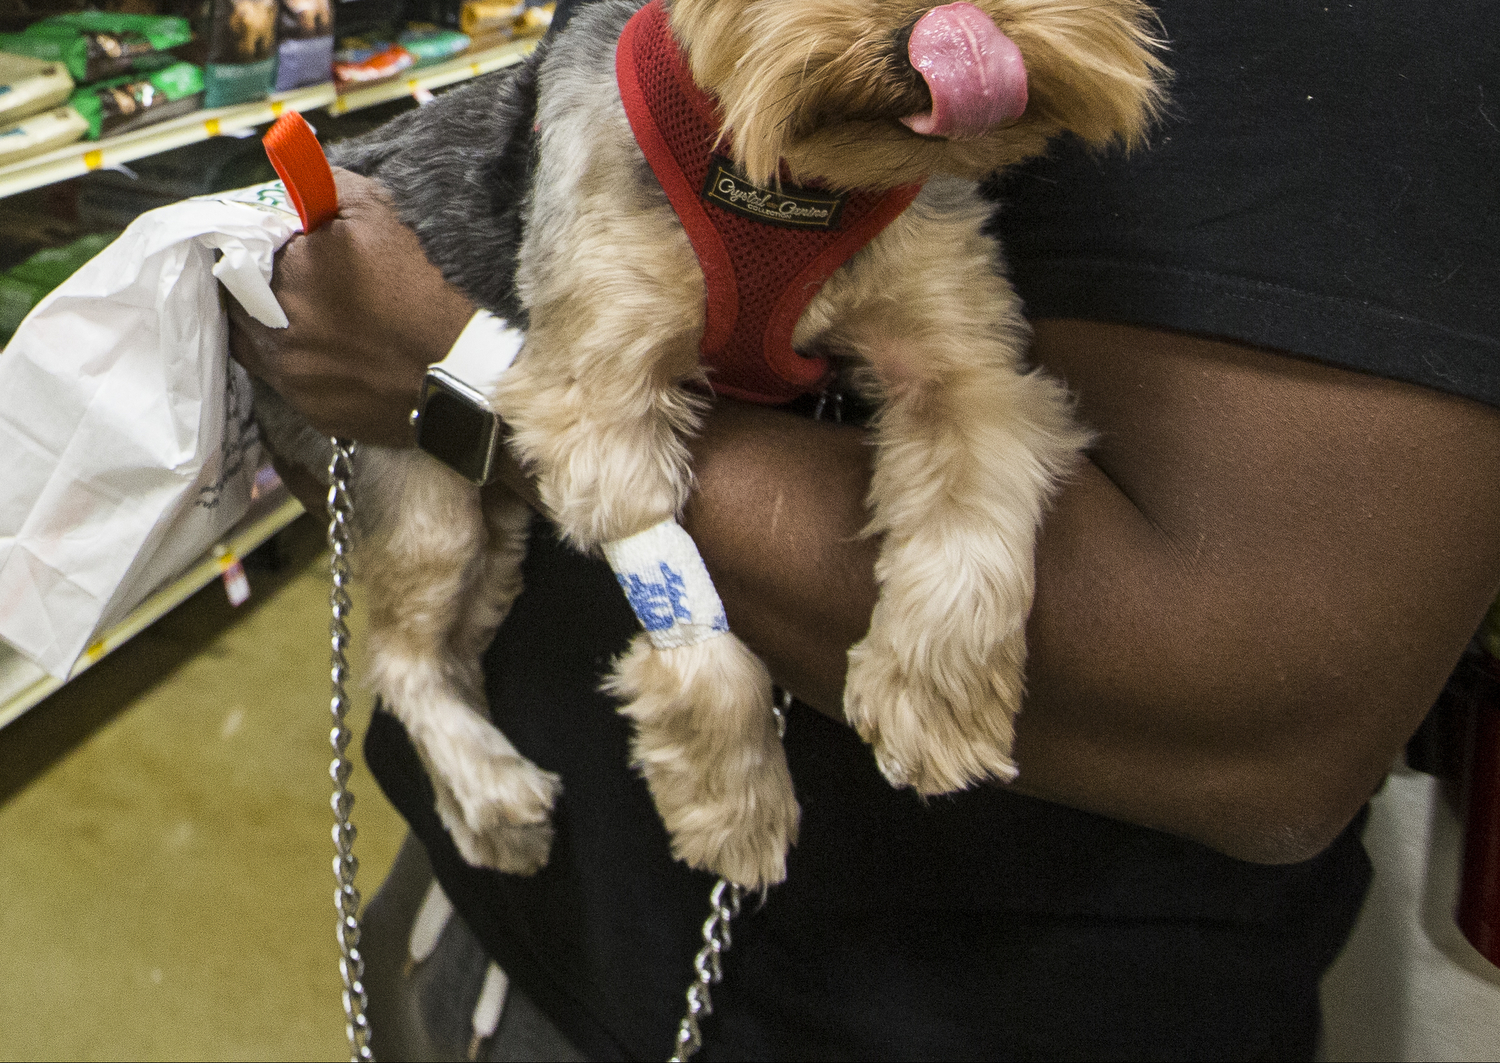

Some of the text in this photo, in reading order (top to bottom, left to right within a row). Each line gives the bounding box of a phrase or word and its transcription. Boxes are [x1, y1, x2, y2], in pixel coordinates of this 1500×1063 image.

[718, 178, 829, 219] Crystal Canine
[747, 203, 792, 220] COLLECTION
